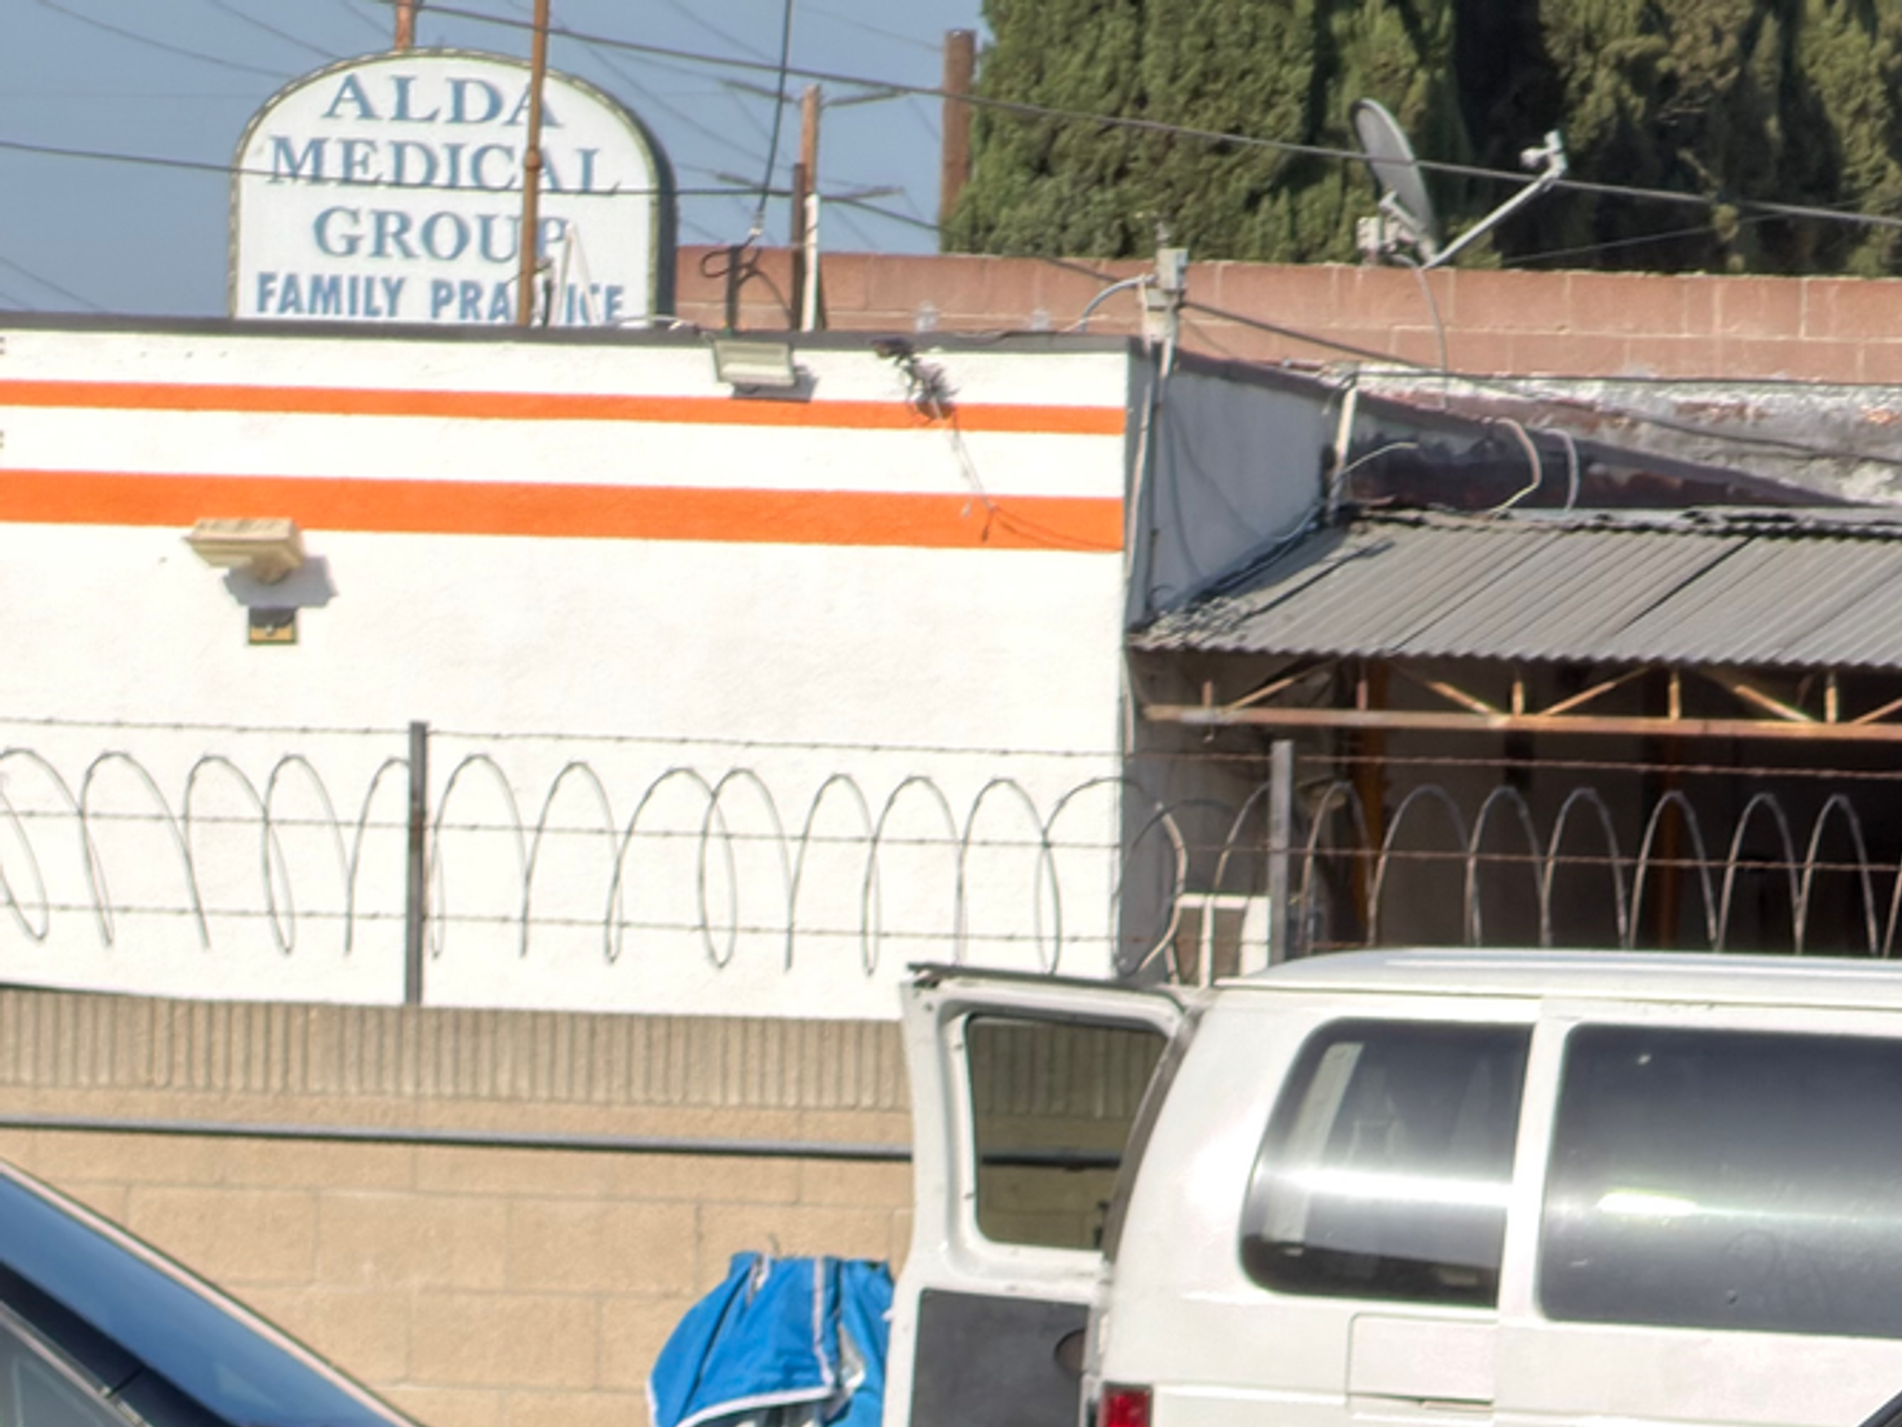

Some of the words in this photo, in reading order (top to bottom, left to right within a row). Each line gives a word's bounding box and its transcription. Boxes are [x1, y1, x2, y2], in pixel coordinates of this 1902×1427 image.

[321, 73, 563, 127] ALDA
[267, 135, 622, 197] MEDICAL
[312, 206, 570, 262] GROUP
[256, 272, 409, 318] FAMILY
[430, 280, 624, 323] PRAIE
